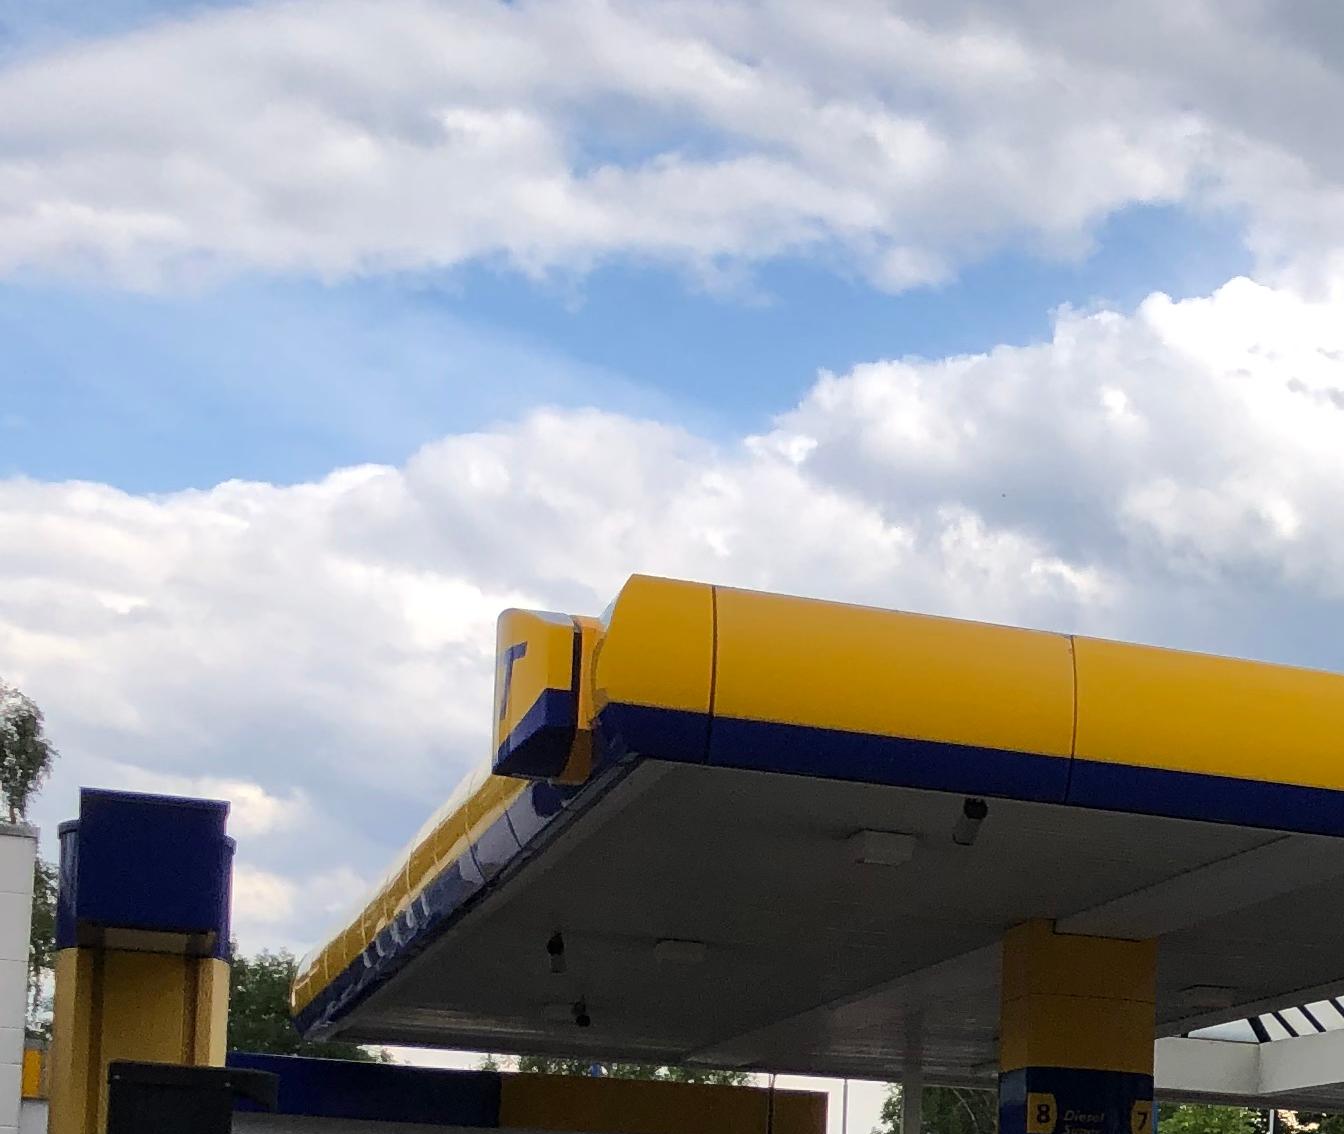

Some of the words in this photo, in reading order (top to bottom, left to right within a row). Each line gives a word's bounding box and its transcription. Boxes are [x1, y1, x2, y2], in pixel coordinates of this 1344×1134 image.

[1037, 1103, 1050, 1123] 8
[1063, 1110, 1105, 1122] Diesel
[1137, 1111, 1148, 1131] 7
